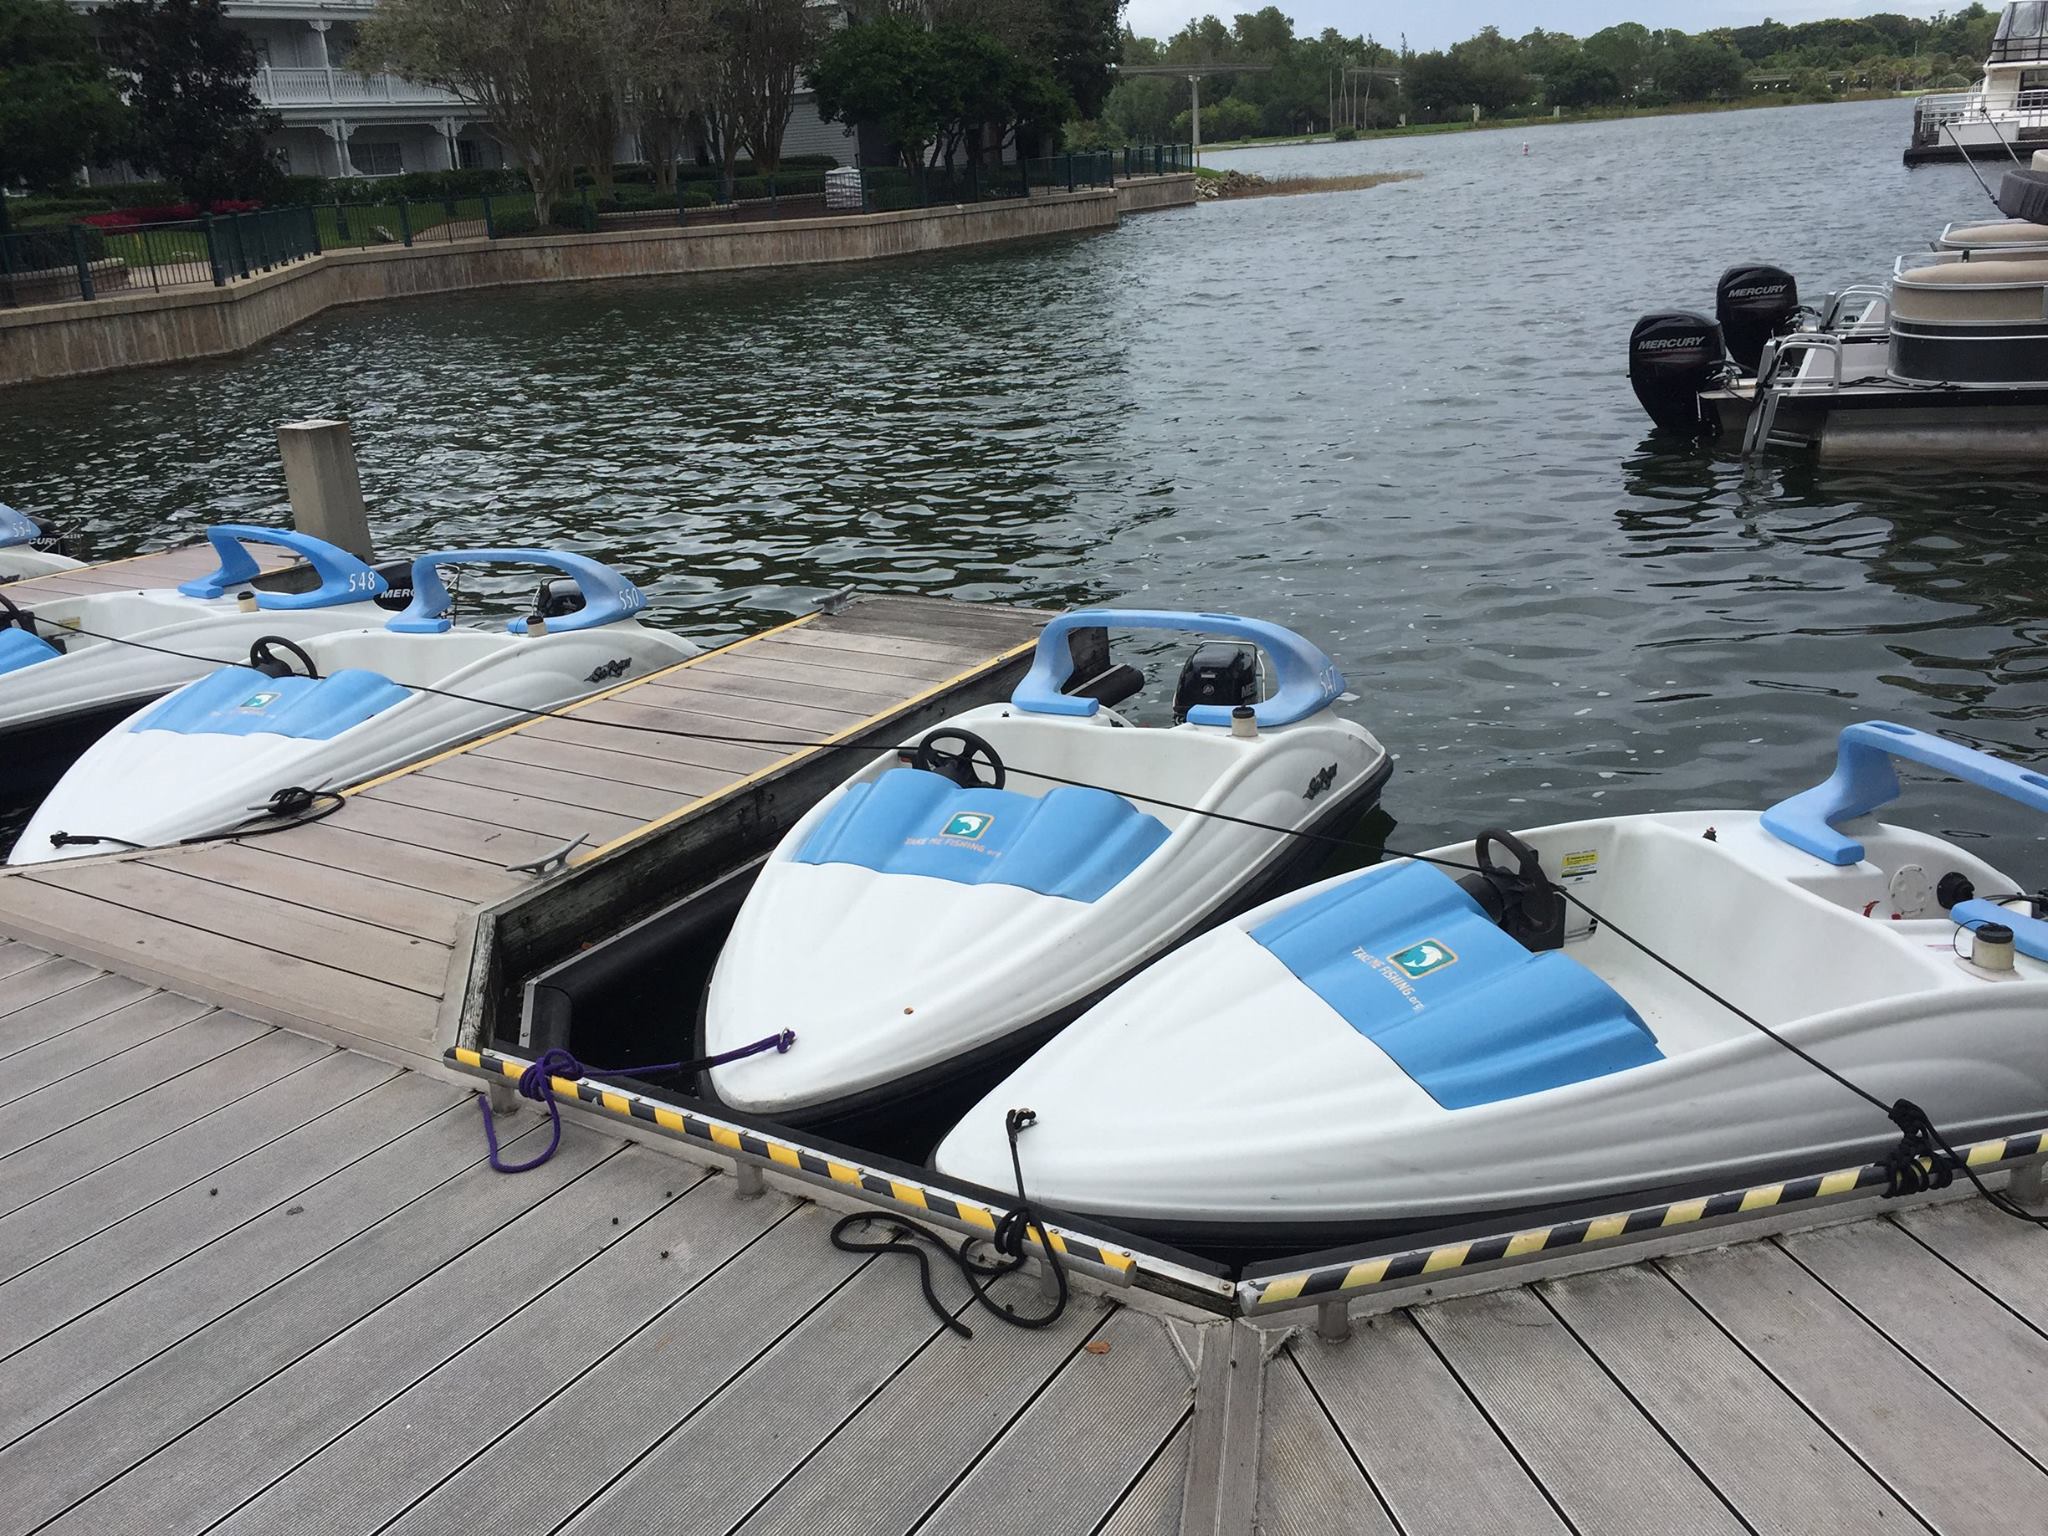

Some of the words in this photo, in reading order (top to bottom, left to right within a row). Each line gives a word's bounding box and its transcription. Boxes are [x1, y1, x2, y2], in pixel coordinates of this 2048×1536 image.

[1728, 284, 1788, 298] MERCURY
[1638, 336, 1706, 350] MERCURY
[348, 571, 376, 593] 548
[619, 587, 640, 611] 550
